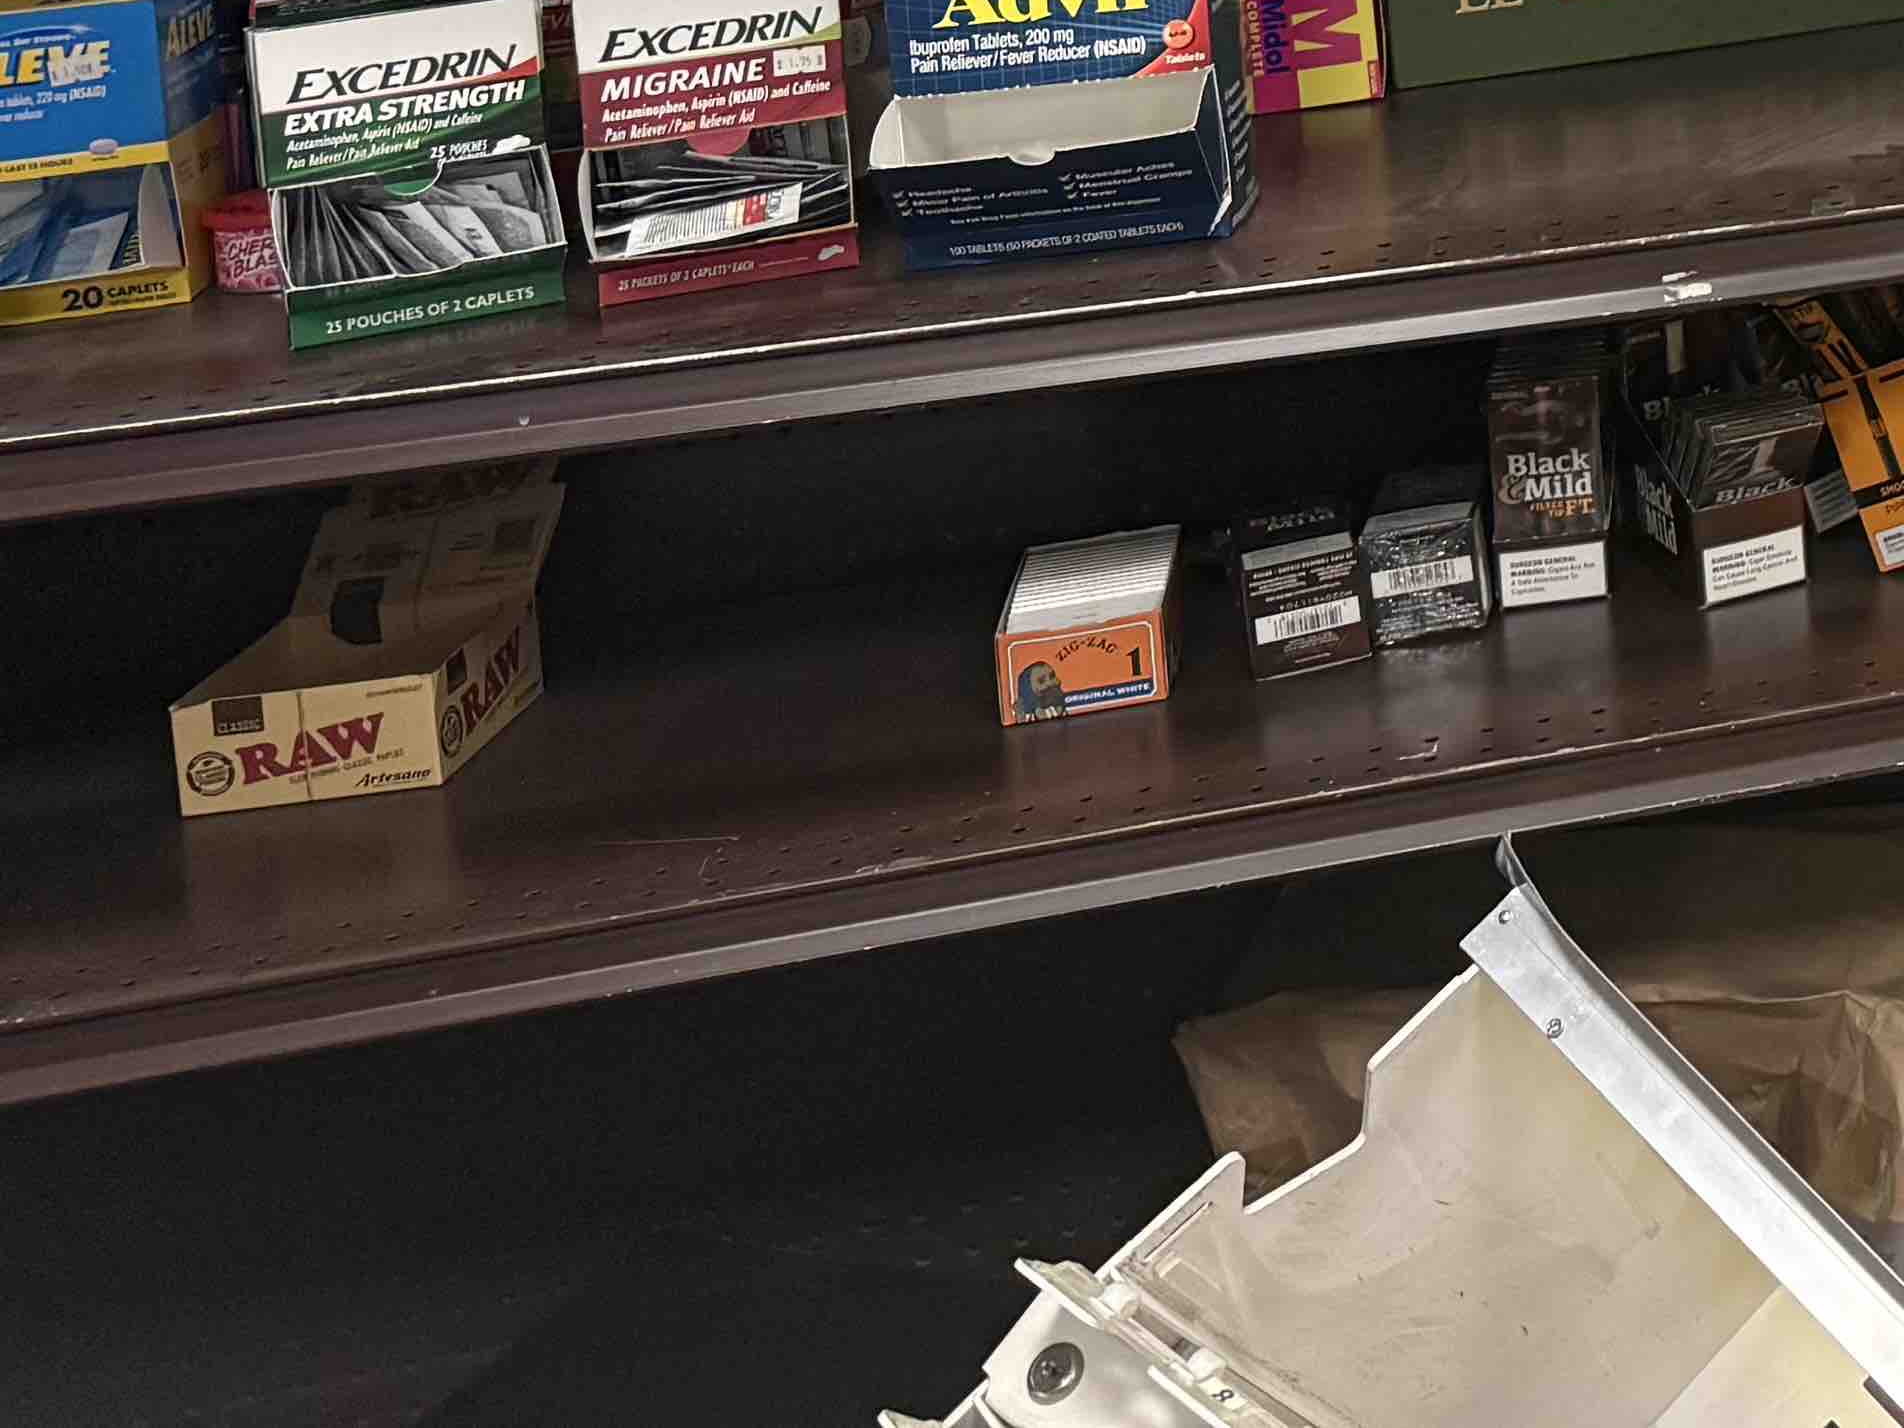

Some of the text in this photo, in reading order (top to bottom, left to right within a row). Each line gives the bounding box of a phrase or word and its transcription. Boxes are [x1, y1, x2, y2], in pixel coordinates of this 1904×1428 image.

[598, 7, 823, 65] EXCEDRIN
[286, 44, 518, 103] EXCEDRIN
[602, 57, 764, 103] MIGRAINE
[284, 80, 526, 136] EXTRA STRENGTH
[62, 281, 168, 311] 20 CAPLETS
[1505, 448, 1590, 476] Black
[1525, 471, 1592, 499] Mild
[235, 712, 384, 785] RAW
